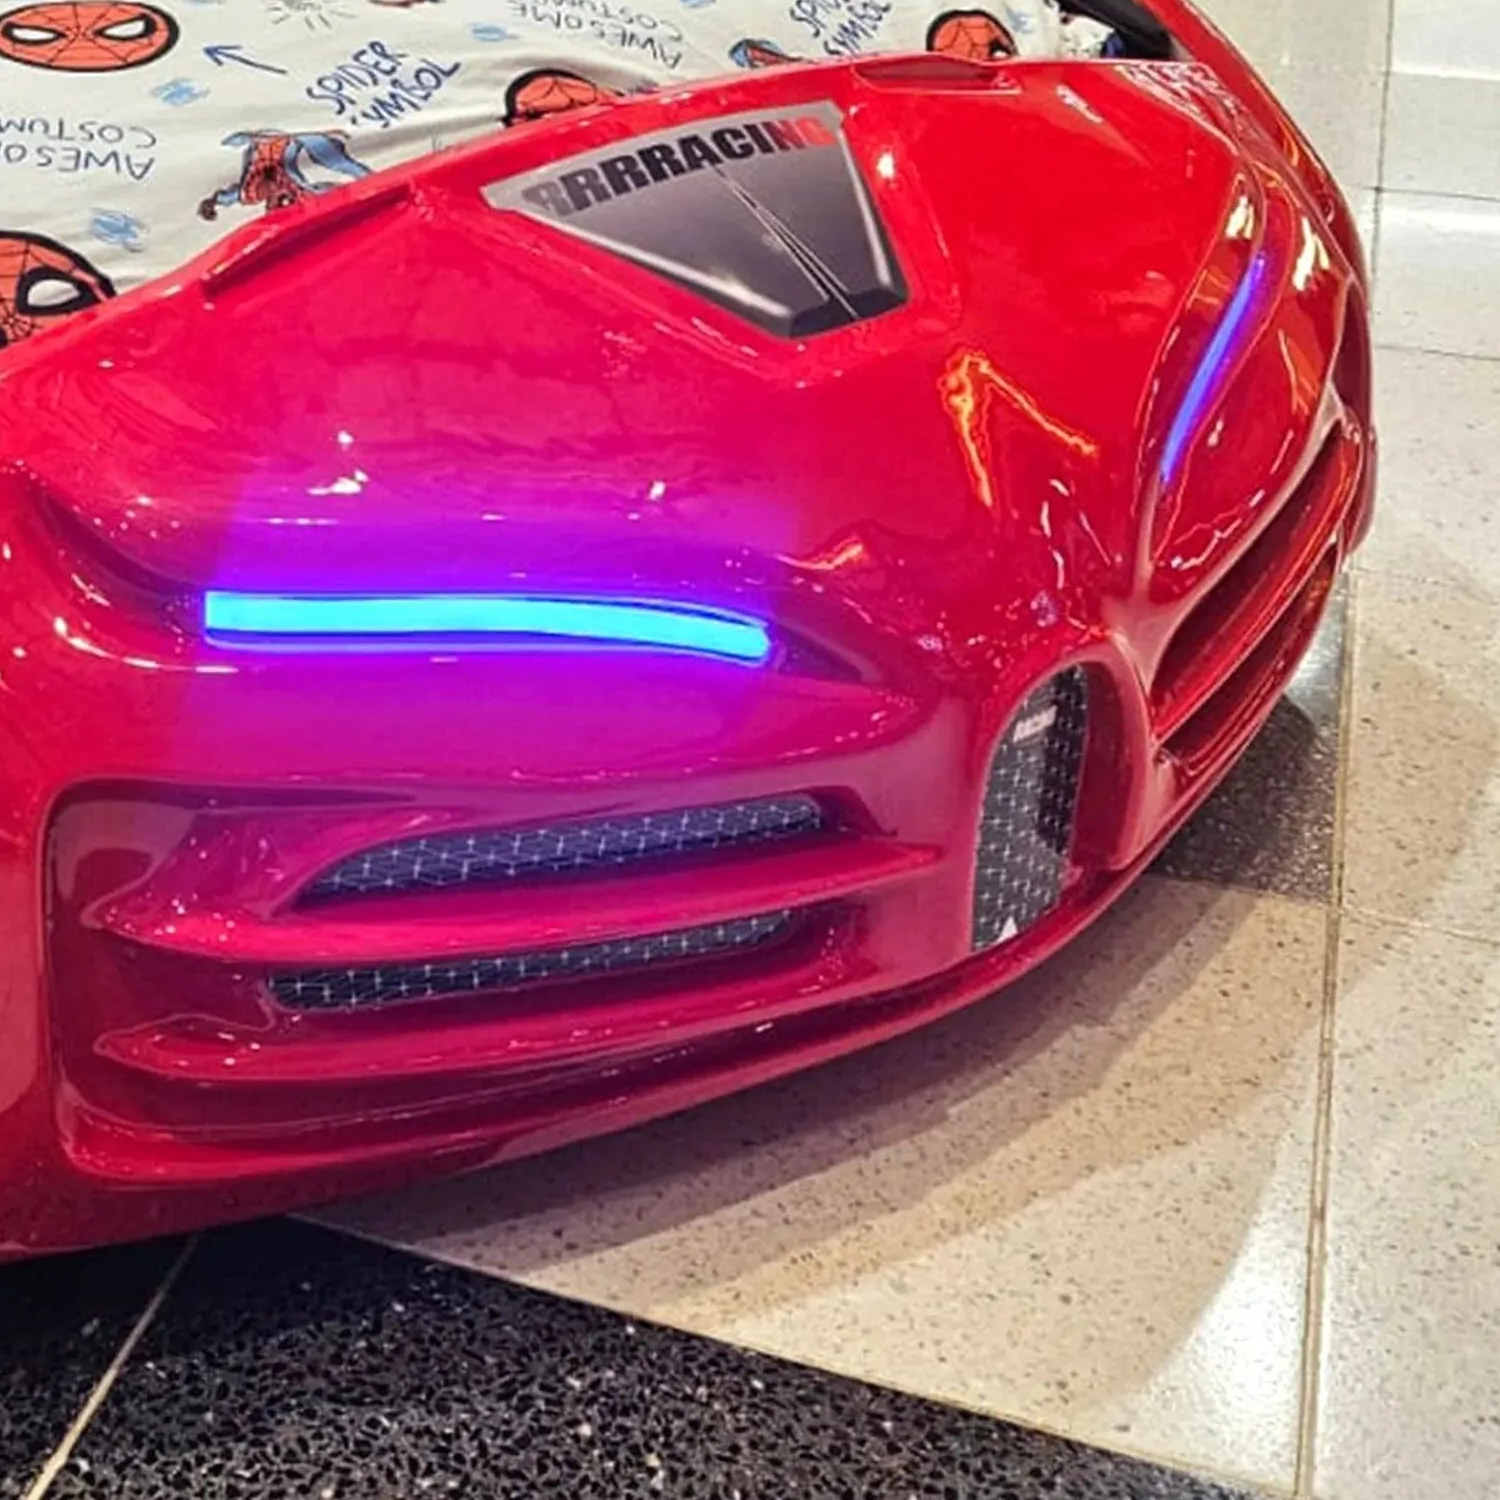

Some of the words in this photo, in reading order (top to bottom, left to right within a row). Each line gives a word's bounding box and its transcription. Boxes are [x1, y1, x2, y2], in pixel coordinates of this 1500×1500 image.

[508, 0, 683, 69] AWESOME
[305, 40, 409, 115] SPIDER
[350, 58, 462, 129] YMBOL
